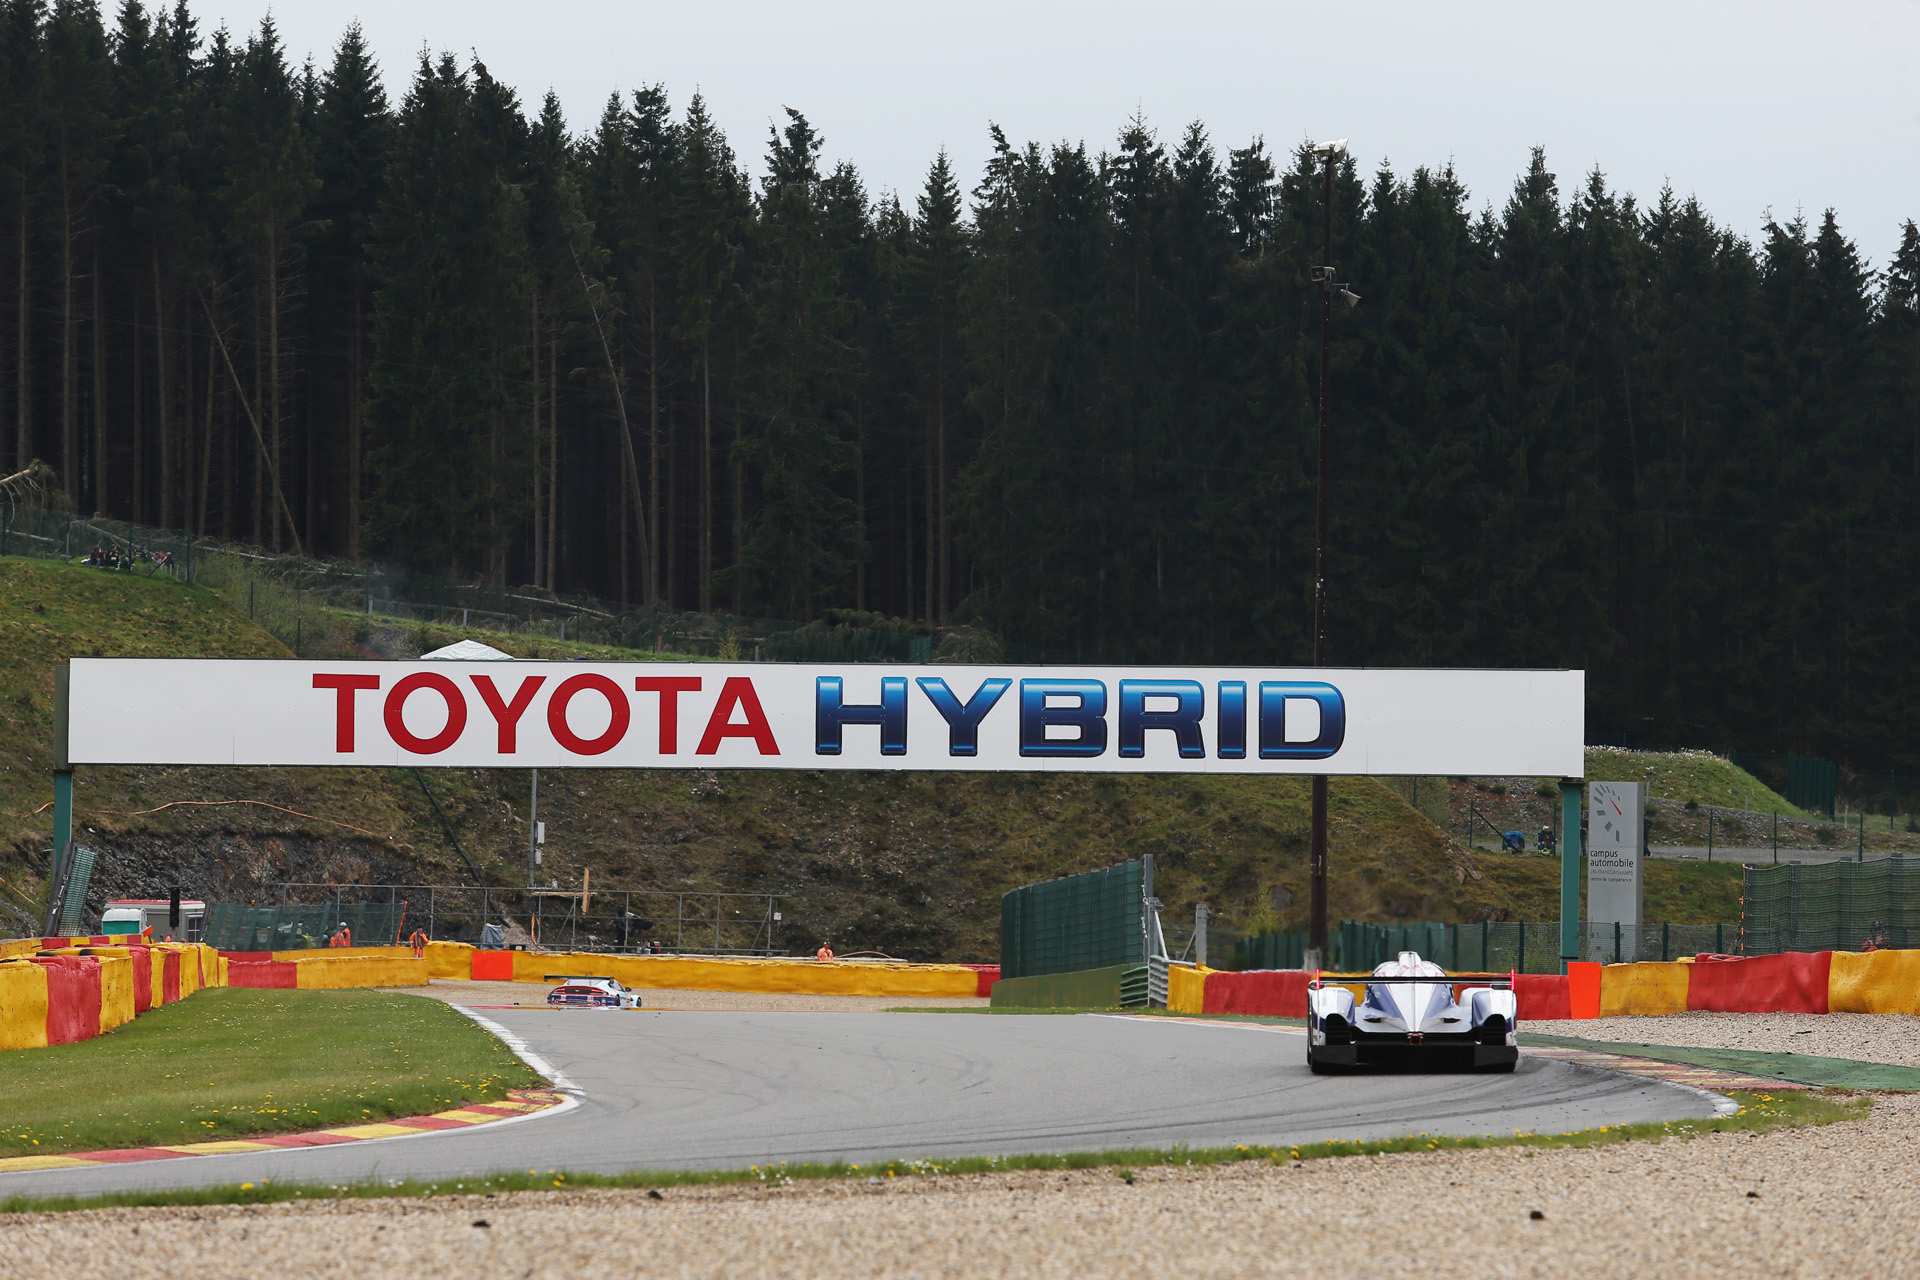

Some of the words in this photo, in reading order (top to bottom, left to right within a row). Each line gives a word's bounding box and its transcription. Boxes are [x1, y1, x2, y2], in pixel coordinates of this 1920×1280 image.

[312, 671, 781, 755] TOYOTA
[814, 676, 1347, 760] HYBRID
[1590, 850, 1618, 859] campus
[1590, 858, 1634, 868] automobile
